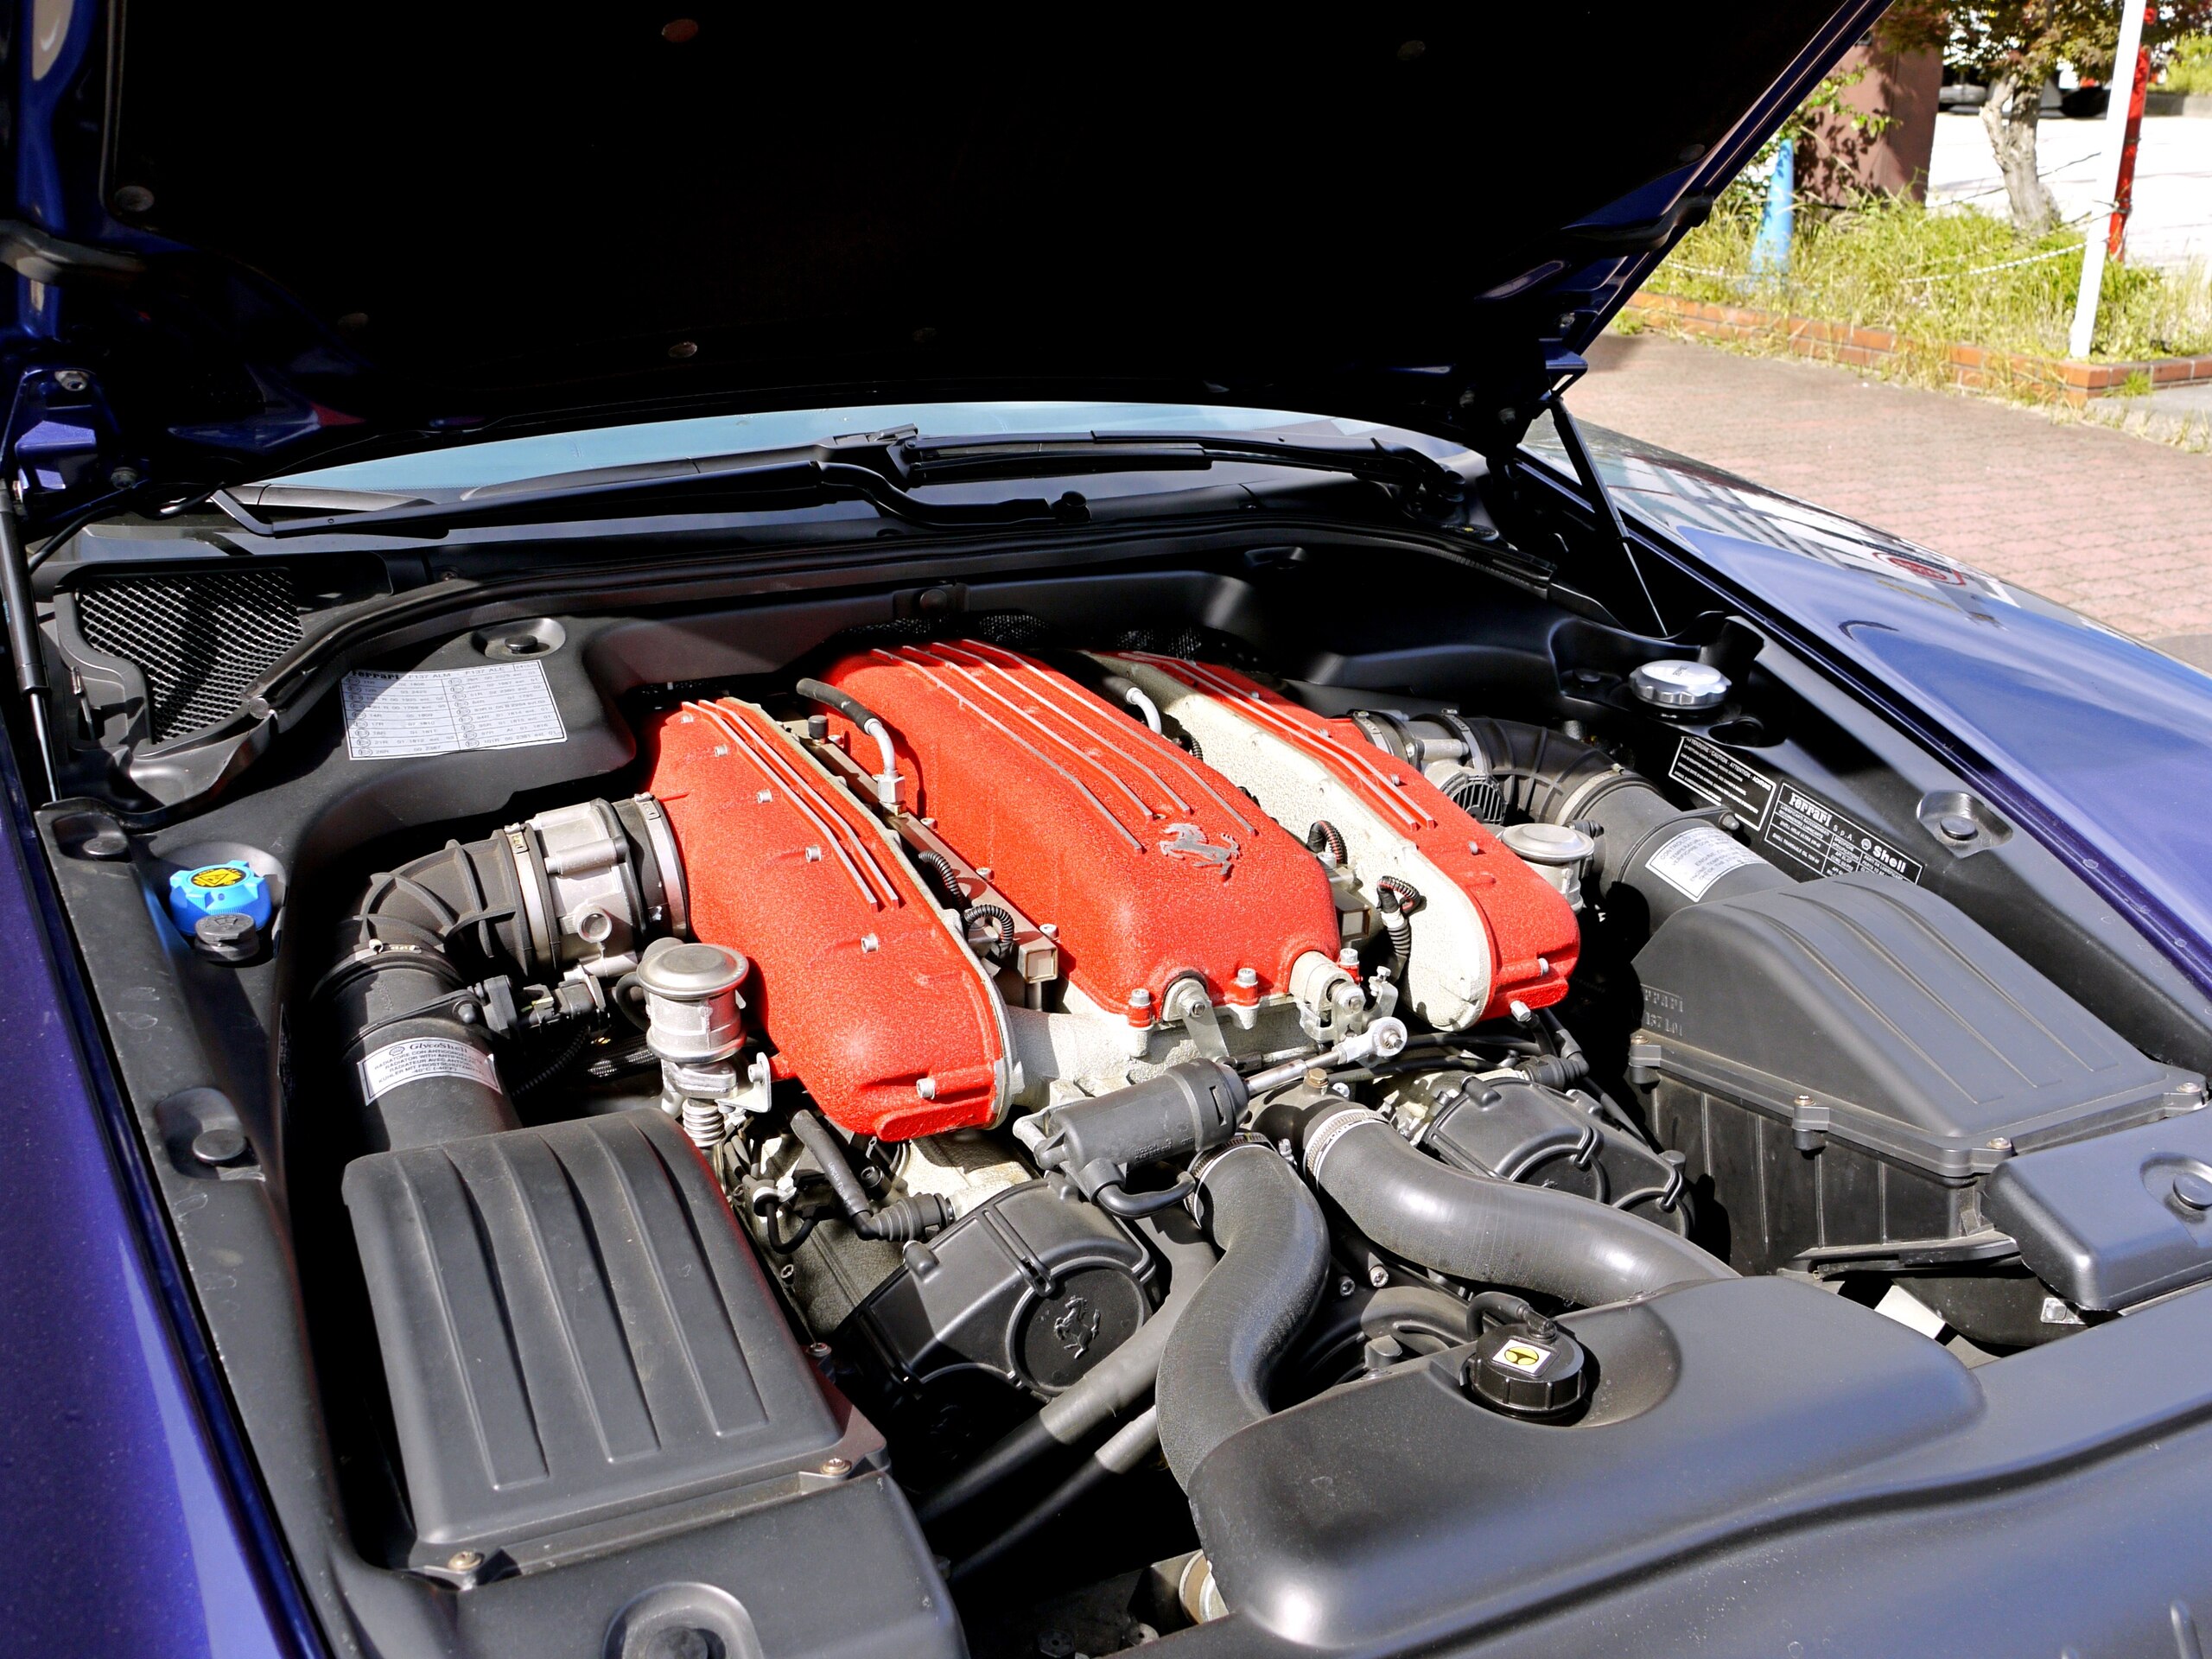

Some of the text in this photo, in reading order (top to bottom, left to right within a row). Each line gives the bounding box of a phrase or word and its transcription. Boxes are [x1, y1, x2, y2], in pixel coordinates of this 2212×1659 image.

[1712, 751, 1727, 763] CAUTION
[1730, 763, 1751, 778] ATTENTION
[1789, 793, 1832, 826] Ferrari
[1833, 824, 1854, 842] S.p.A.
[1872, 845, 1906, 873] Shell
[410, 1042, 467, 1052] GlycoShell
[374, 1052, 410, 1069] RADIATORE
[385, 1055, 418, 1069] RADIATOR
[389, 1058, 427, 1071] RADIATEUR
